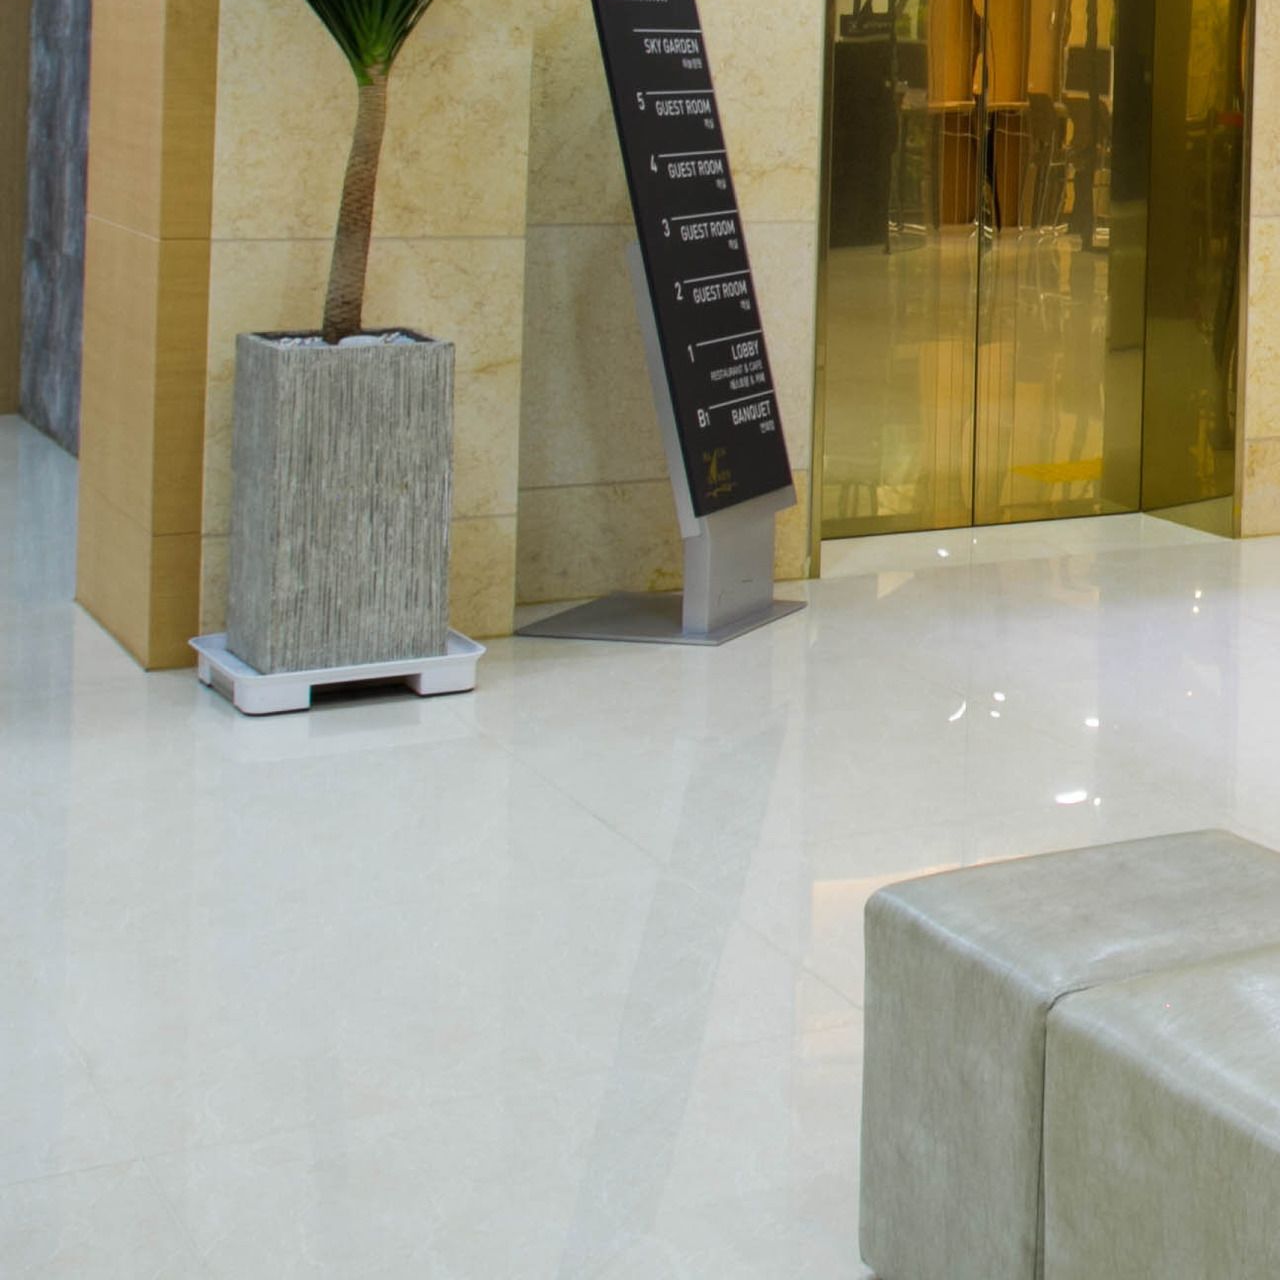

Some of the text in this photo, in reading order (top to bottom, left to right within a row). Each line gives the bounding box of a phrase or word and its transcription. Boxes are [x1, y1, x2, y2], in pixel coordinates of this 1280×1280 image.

[643, 37, 699, 55] SKY GARDEN
[636, 91, 646, 111] 5
[655, 98, 712, 117] GUEST ROOM
[650, 154, 658, 173] 4
[667, 159, 724, 179] GUEST ROOM
[661, 218, 671, 238] 3
[680, 220, 736, 242] GUEST ROOM
[674, 281, 683, 301] 2
[692, 280, 748, 304] GUEST ROOM
[687, 344, 695, 363] 1
[731, 339, 759, 360] LOBBY
[697, 408, 711, 428] B1
[731, 399, 771, 425] BANQUET
